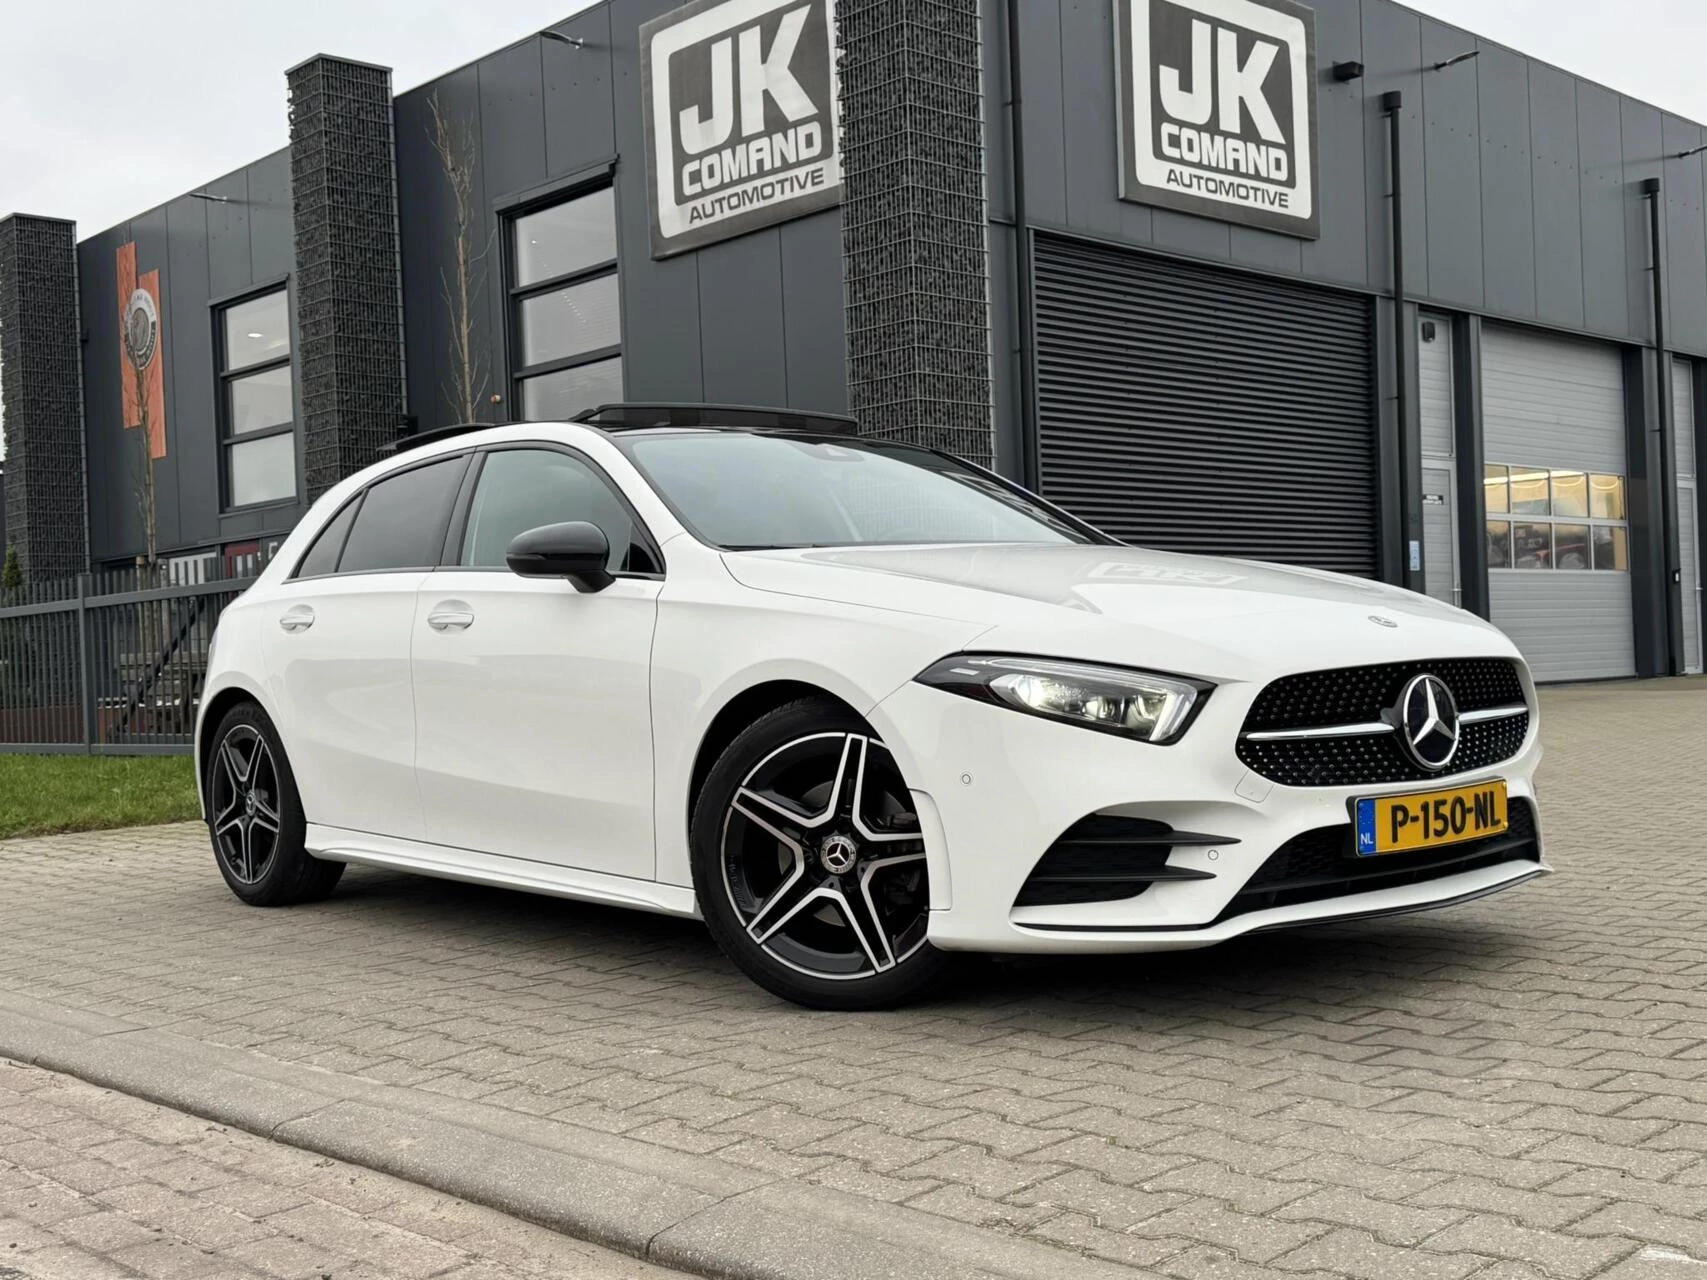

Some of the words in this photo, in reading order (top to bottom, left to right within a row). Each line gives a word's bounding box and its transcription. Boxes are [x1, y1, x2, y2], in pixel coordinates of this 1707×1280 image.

[680, 4, 819, 155] JK
[1159, 18, 1286, 145] JK
[682, 121, 822, 196] COMAND
[1161, 122, 1288, 182] COMAND
[689, 167, 824, 224] AUTOMOTIVE
[1166, 169, 1289, 208] AUTOMOTIVE
[1360, 833, 1373, 845] NL
[1391, 791, 1501, 844] P-150-NL
